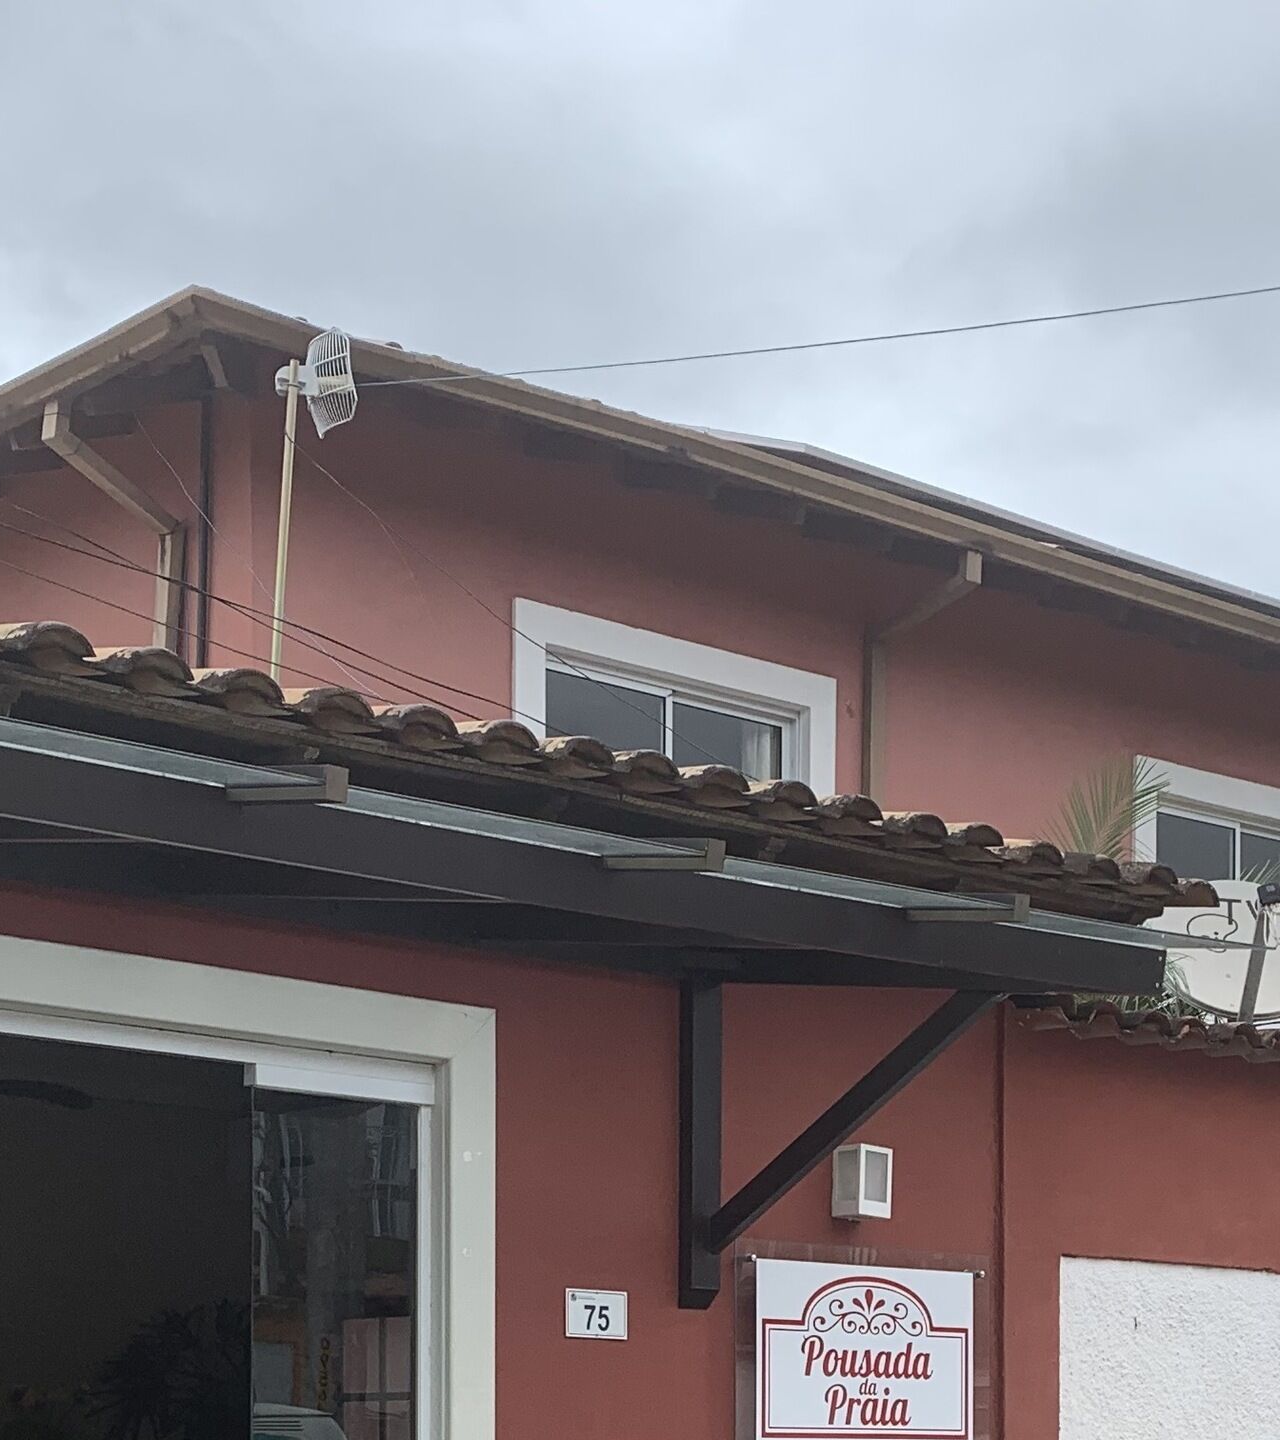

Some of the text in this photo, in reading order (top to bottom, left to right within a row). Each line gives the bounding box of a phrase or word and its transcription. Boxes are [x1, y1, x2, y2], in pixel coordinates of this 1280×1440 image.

[583, 1304, 610, 1332] 75
[801, 1335, 933, 1380] Pousada
[859, 1378, 878, 1396] da
[824, 1384, 911, 1427] Praia
